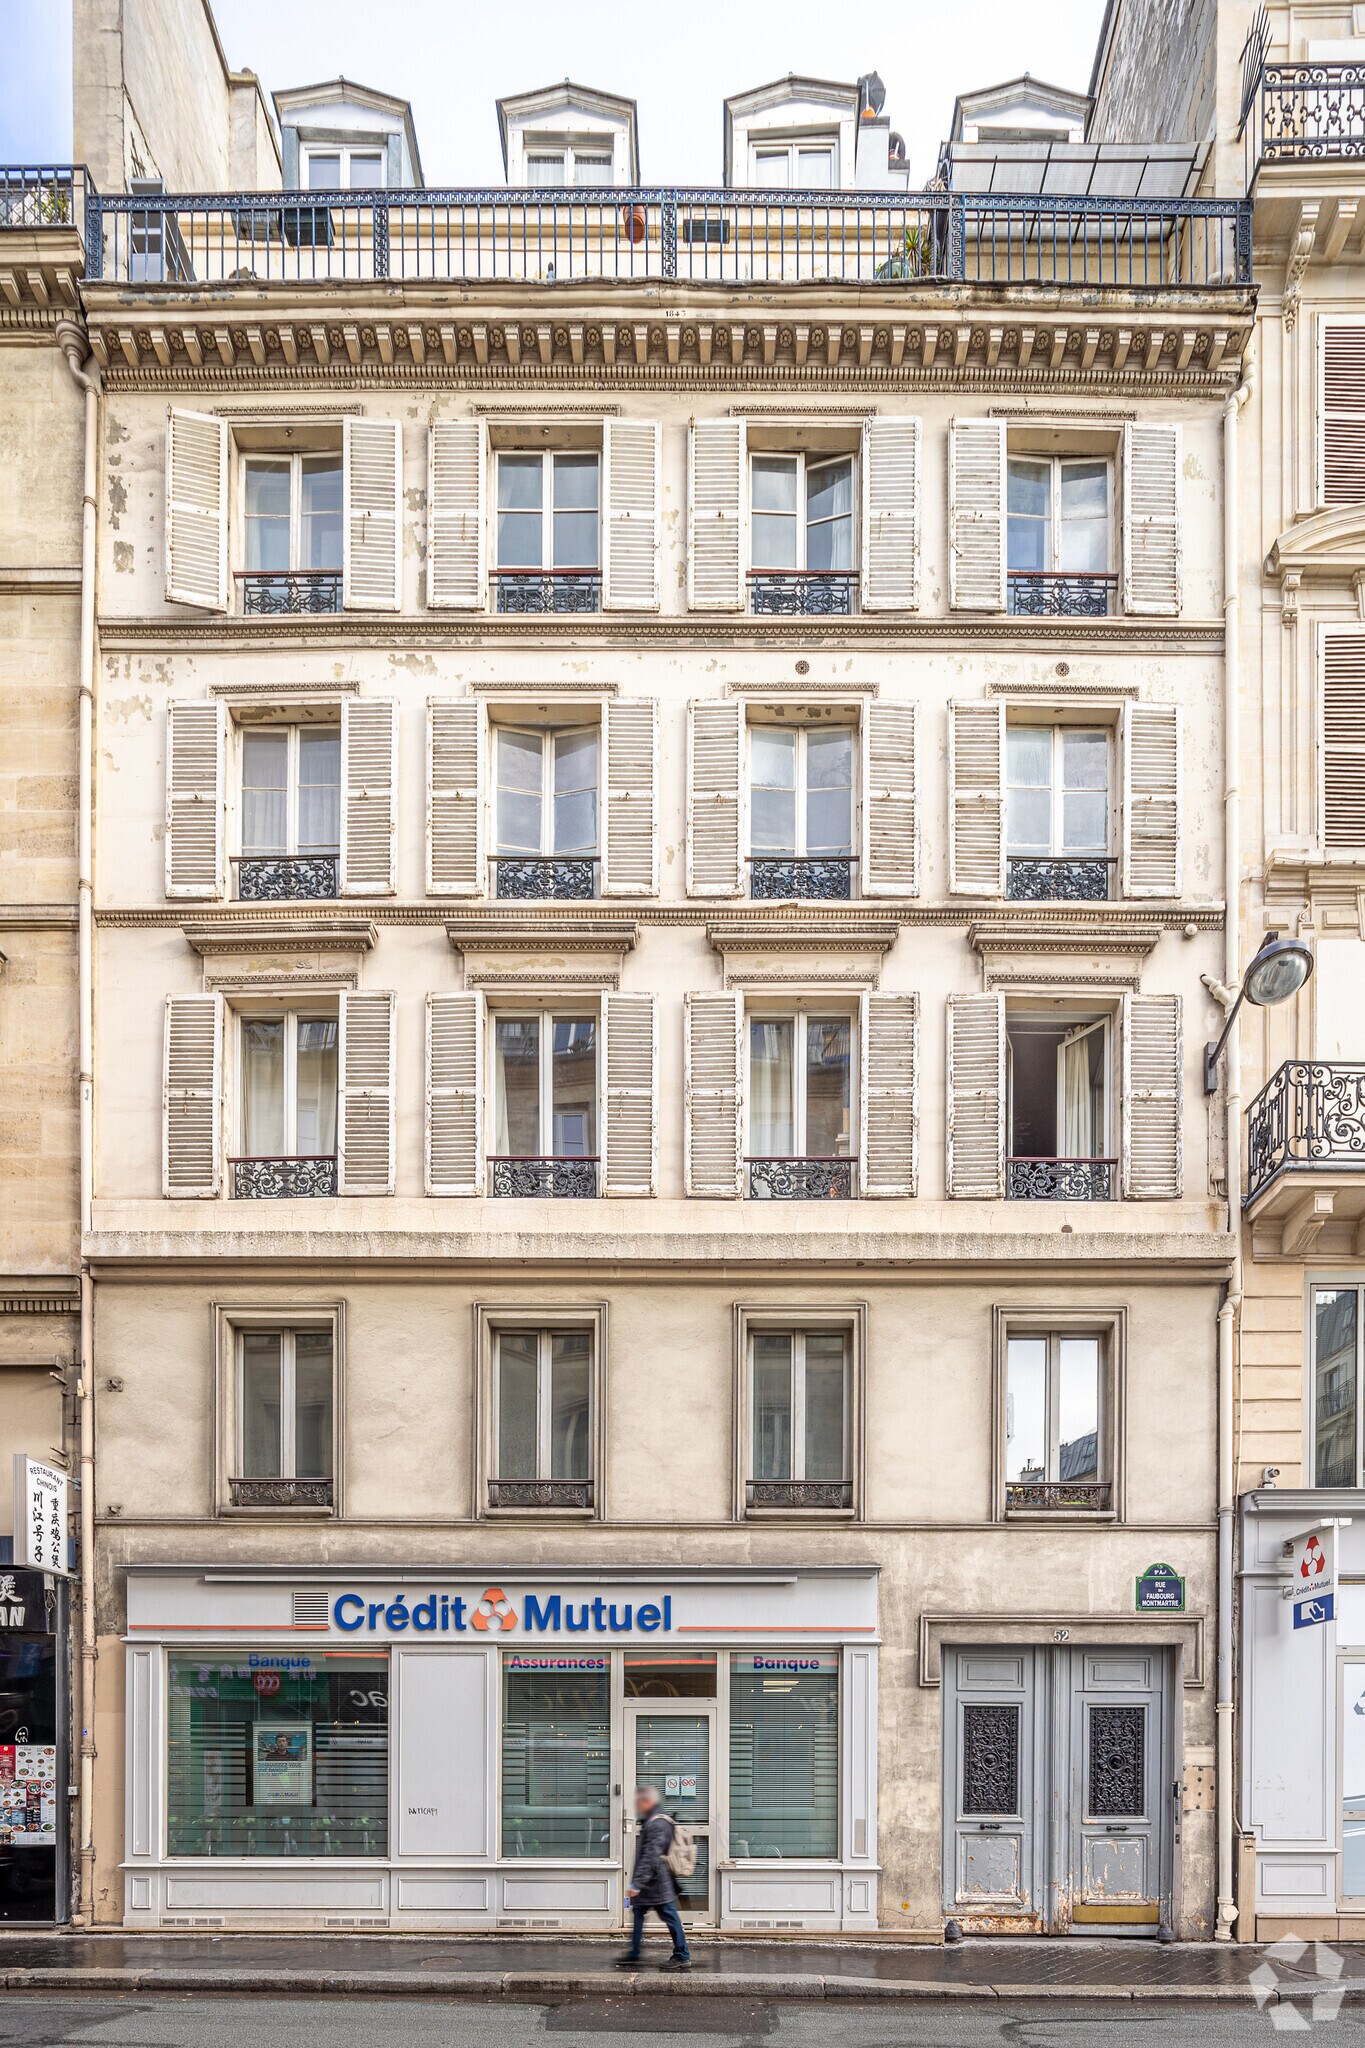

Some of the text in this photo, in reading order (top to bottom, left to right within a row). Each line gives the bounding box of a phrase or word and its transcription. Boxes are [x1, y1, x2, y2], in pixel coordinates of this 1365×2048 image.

[29, 1467, 63, 1487] RESTAURANT
[36, 1478, 57, 1492] CHINOIS
[334, 1593, 672, 1632] Crédit Mutuel
[1053, 1630, 1070, 1642] 52
[248, 1653, 311, 1670] Banque
[510, 1655, 605, 1669] Assurances
[753, 1655, 820, 1672] Banque
